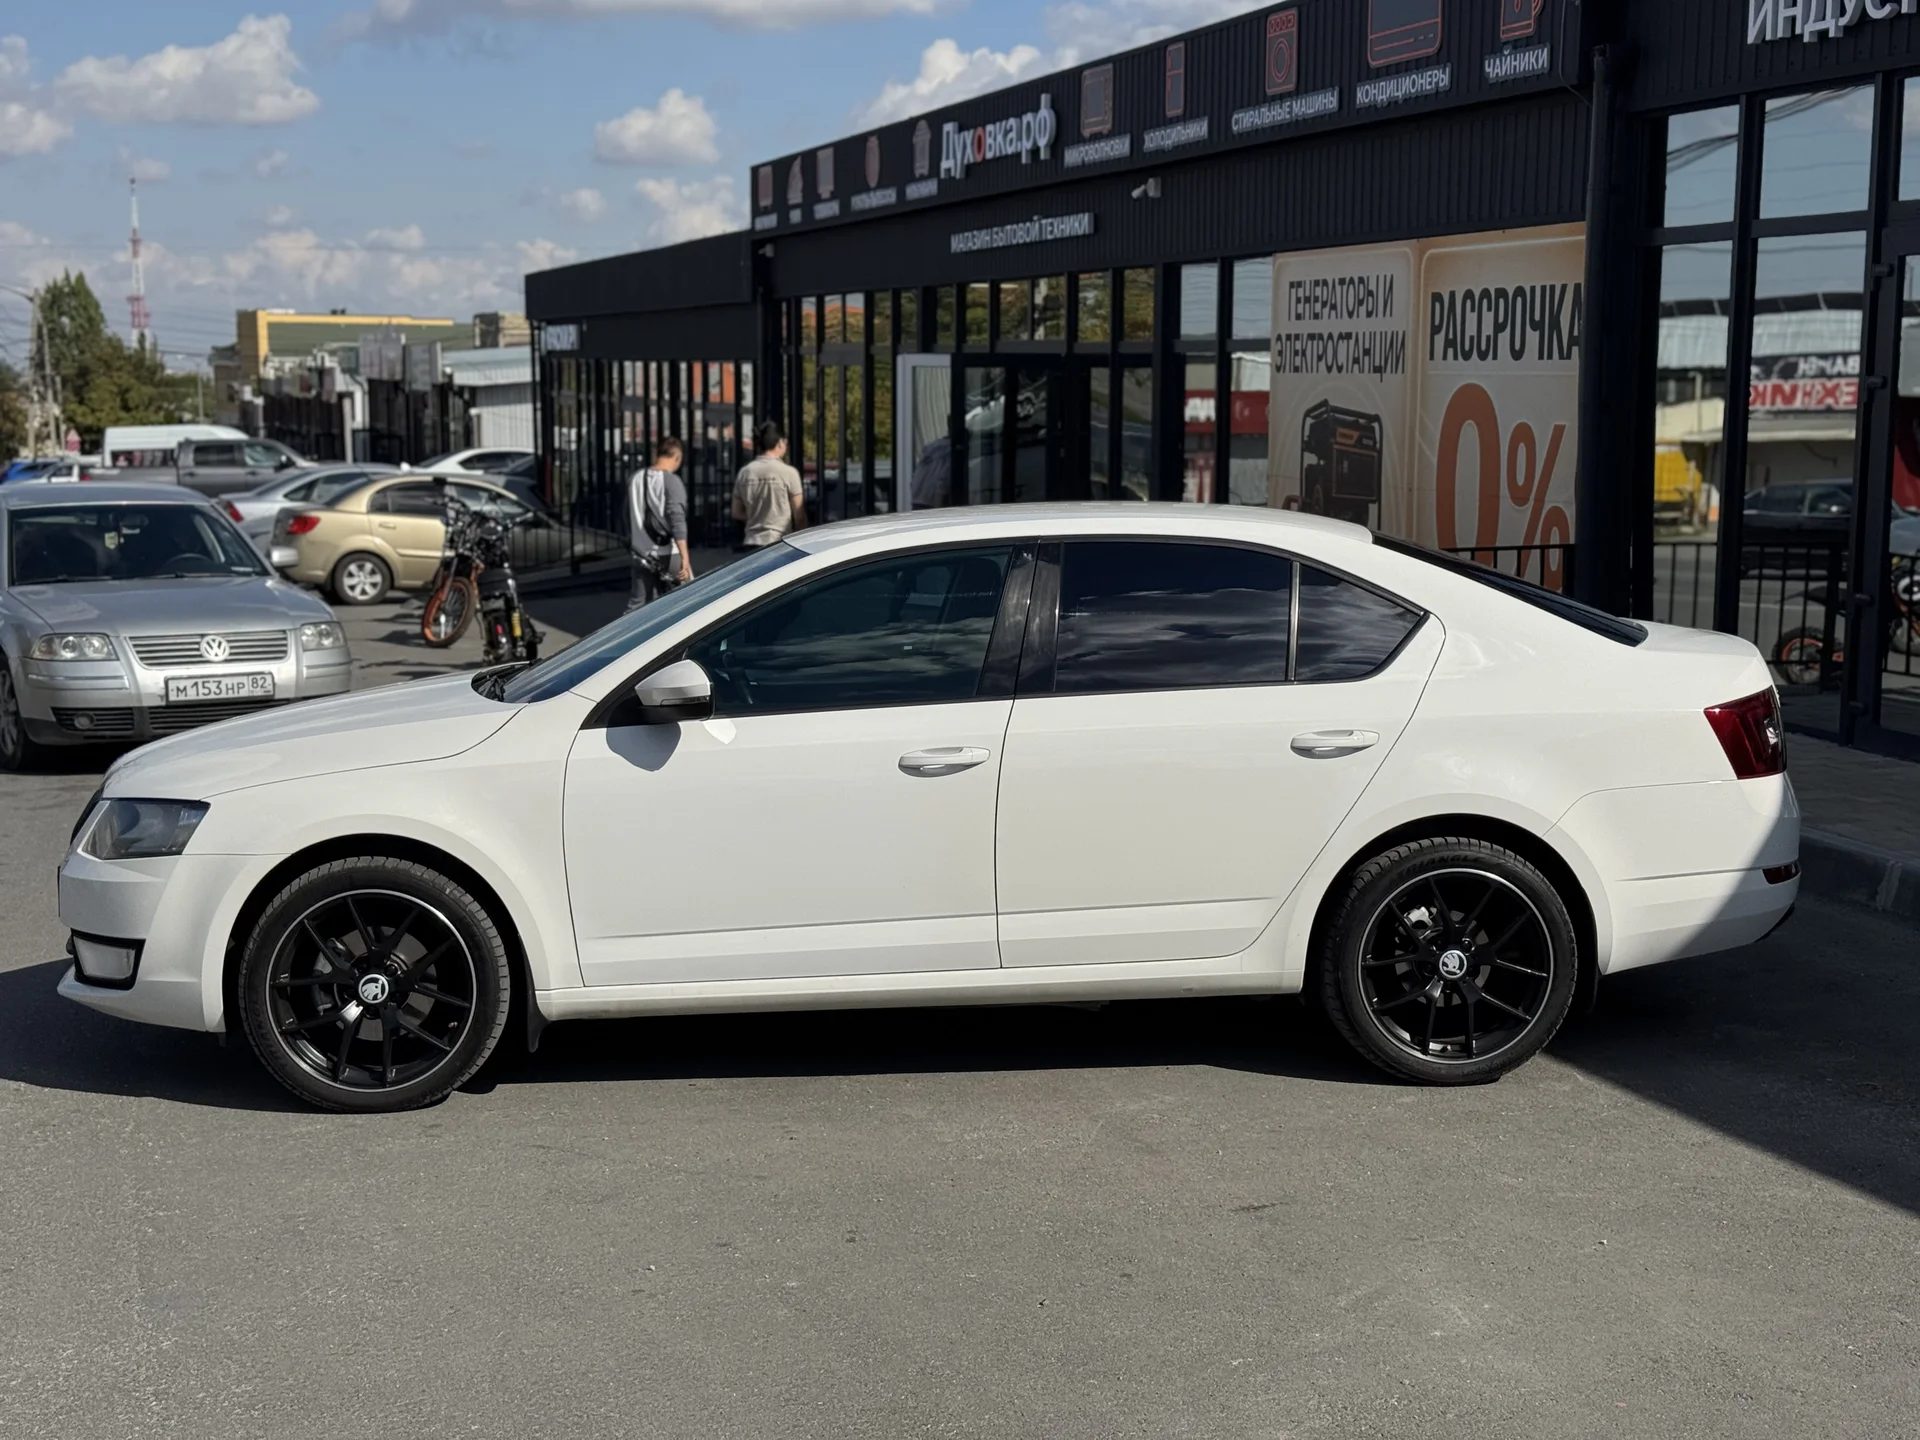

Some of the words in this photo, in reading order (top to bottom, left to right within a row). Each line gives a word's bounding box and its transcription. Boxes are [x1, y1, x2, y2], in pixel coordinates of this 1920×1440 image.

[1747, 0, 1917, 44] ИНДУ
[1485, 48, 1548, 77] ЧАЙНИКИ
[1356, 68, 1449, 104] КОНДИЦИОНЕРЫ
[1232, 102, 1290, 130] СТИРАЛЬНЫЕ
[1293, 91, 1337, 117] МАШИНЫ
[940, 93, 1056, 179] Духовка.рф
[1144, 117, 1208, 152] ХОЛОДИЛЬНИКИ
[951, 228, 991, 253] МАГАЗИН
[992, 215, 1040, 247] БЫТОВОЙ
[1041, 212, 1093, 240] ТЕХНИКИ
[1288, 275, 1379, 321] ГЕНЕРАТОРЫ
[1383, 274, 1393, 318] И
[1429, 282, 1583, 362] РАССРОЧКА
[1275, 330, 1405, 383] ЭЛЕКТРОСТАНЦИИ
[1436, 383, 1571, 593] 0%
